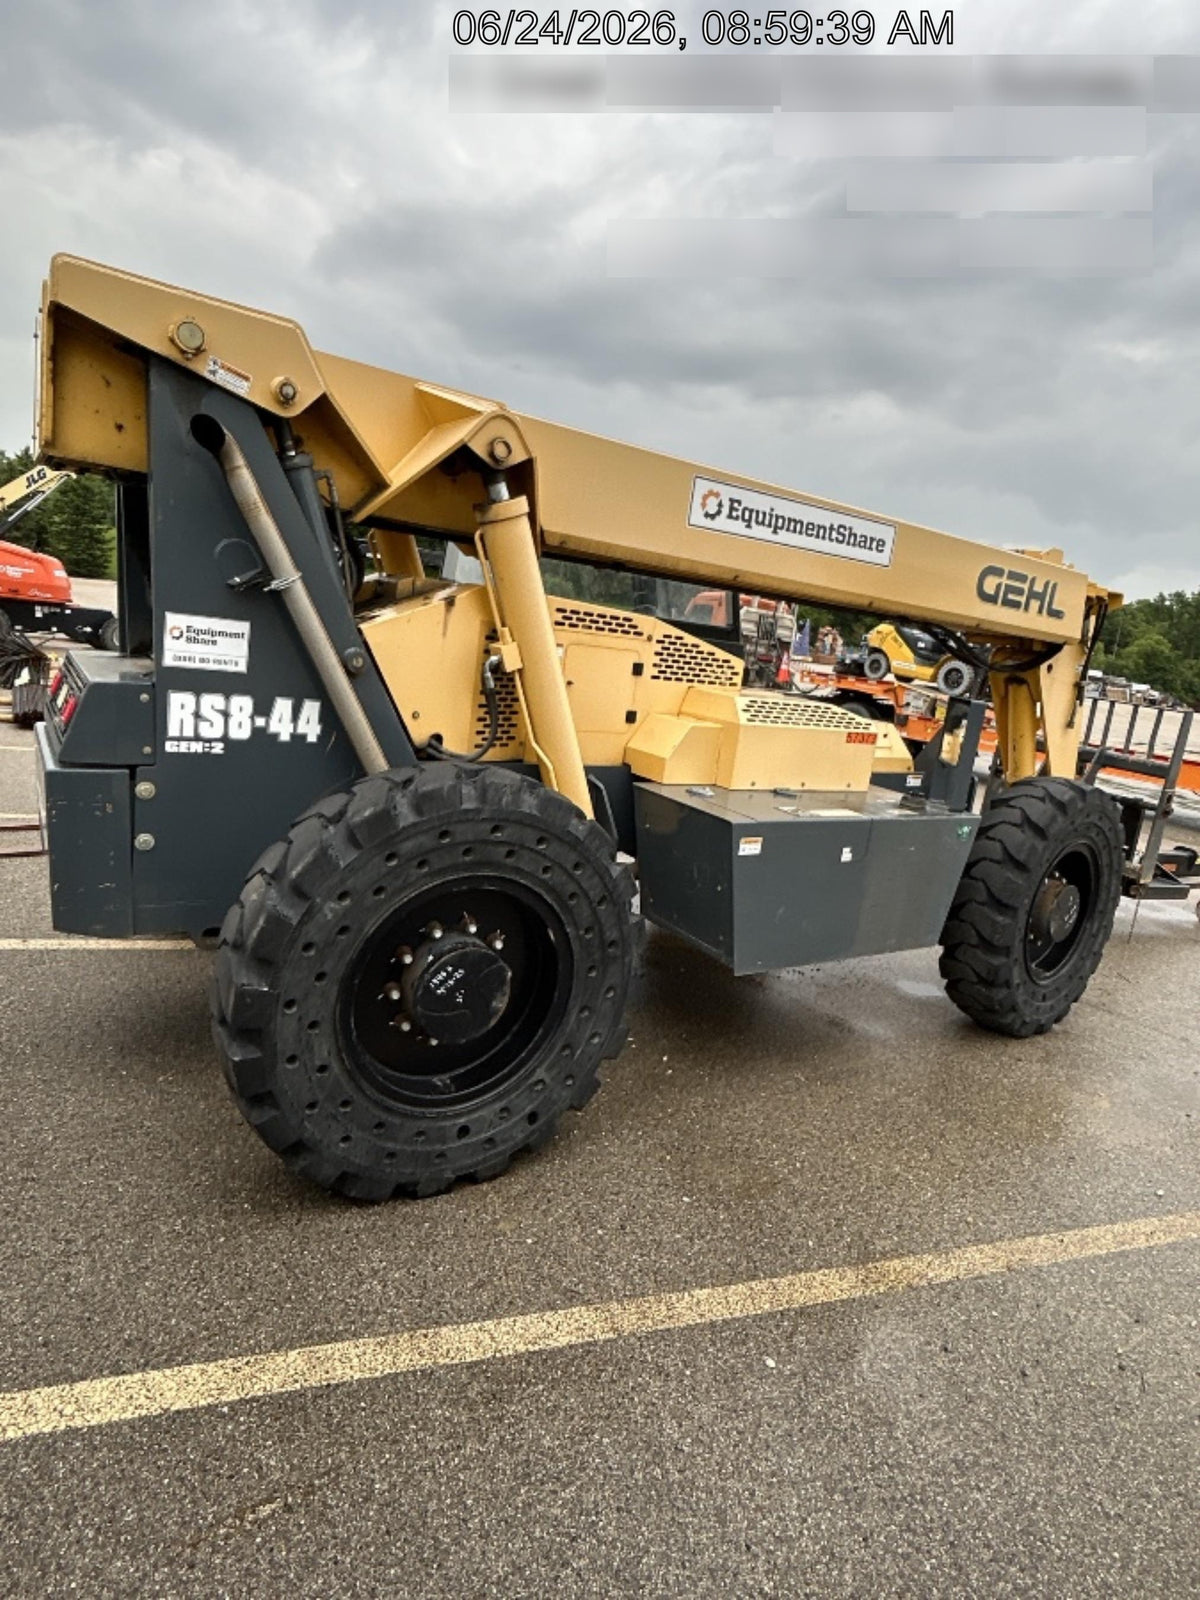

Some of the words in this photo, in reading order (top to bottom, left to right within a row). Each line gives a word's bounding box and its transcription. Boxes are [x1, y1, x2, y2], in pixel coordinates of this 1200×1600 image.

[25, 468, 47, 489] JLG
[726, 497, 886, 553] EquipmentShare
[976, 564, 1065, 620] GEHL
[185, 625, 246, 640] Equipment
[185, 636, 218, 647] Share
[167, 690, 322, 742] RS8-44
